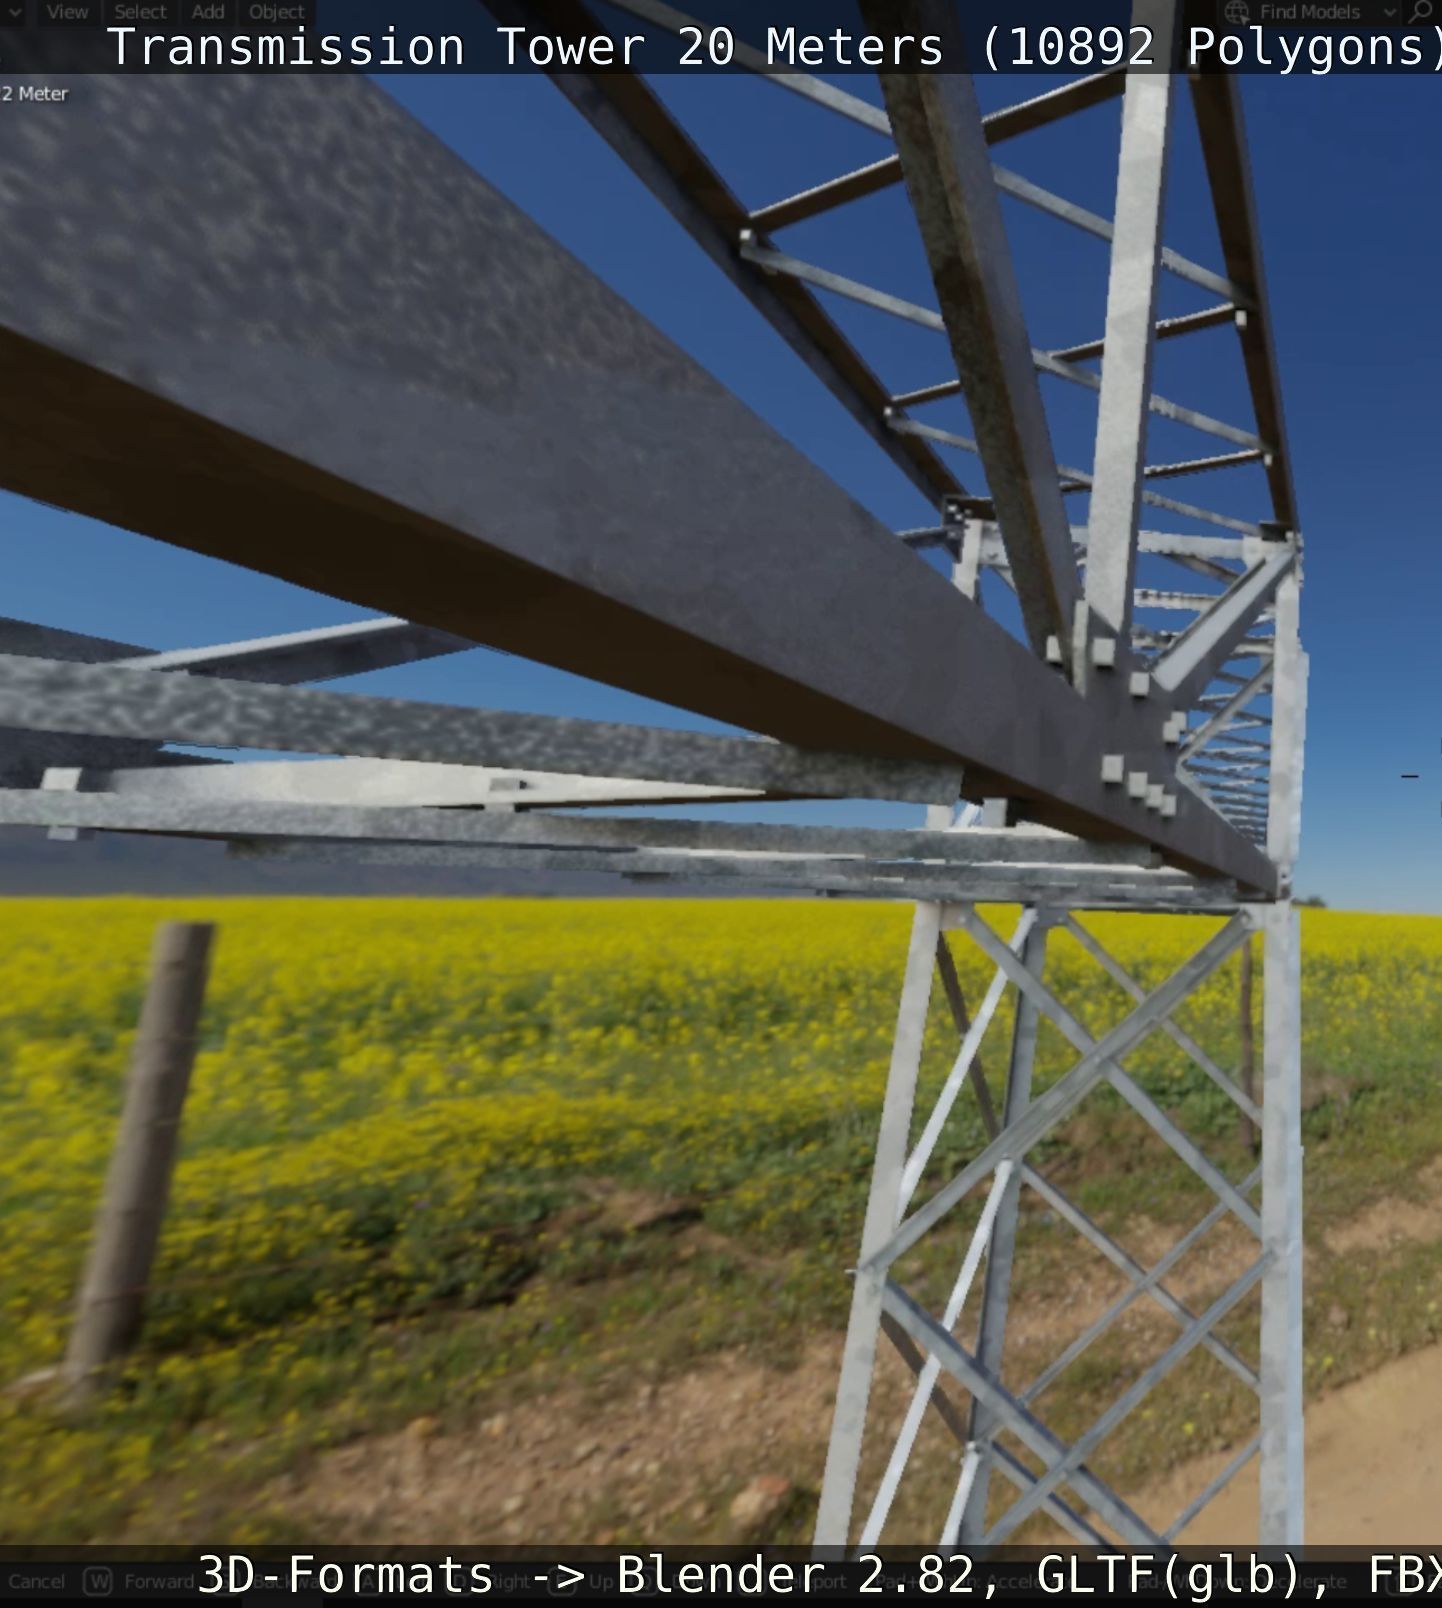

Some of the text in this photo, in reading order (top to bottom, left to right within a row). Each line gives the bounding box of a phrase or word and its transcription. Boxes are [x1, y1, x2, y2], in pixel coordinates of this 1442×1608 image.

[47, 4, 89, 20] View
[114, 4, 168, 20] Select
[191, 4, 226, 20] Add
[248, 4, 306, 23] Object
[1260, 4, 1362, 20] Find Models
[19, 86, 69, 101] Meter
[8, 1573, 65, 1589] Cancel
[125, 1573, 195, 1589] Forward
[589, 1573, 614, 1593] Up
